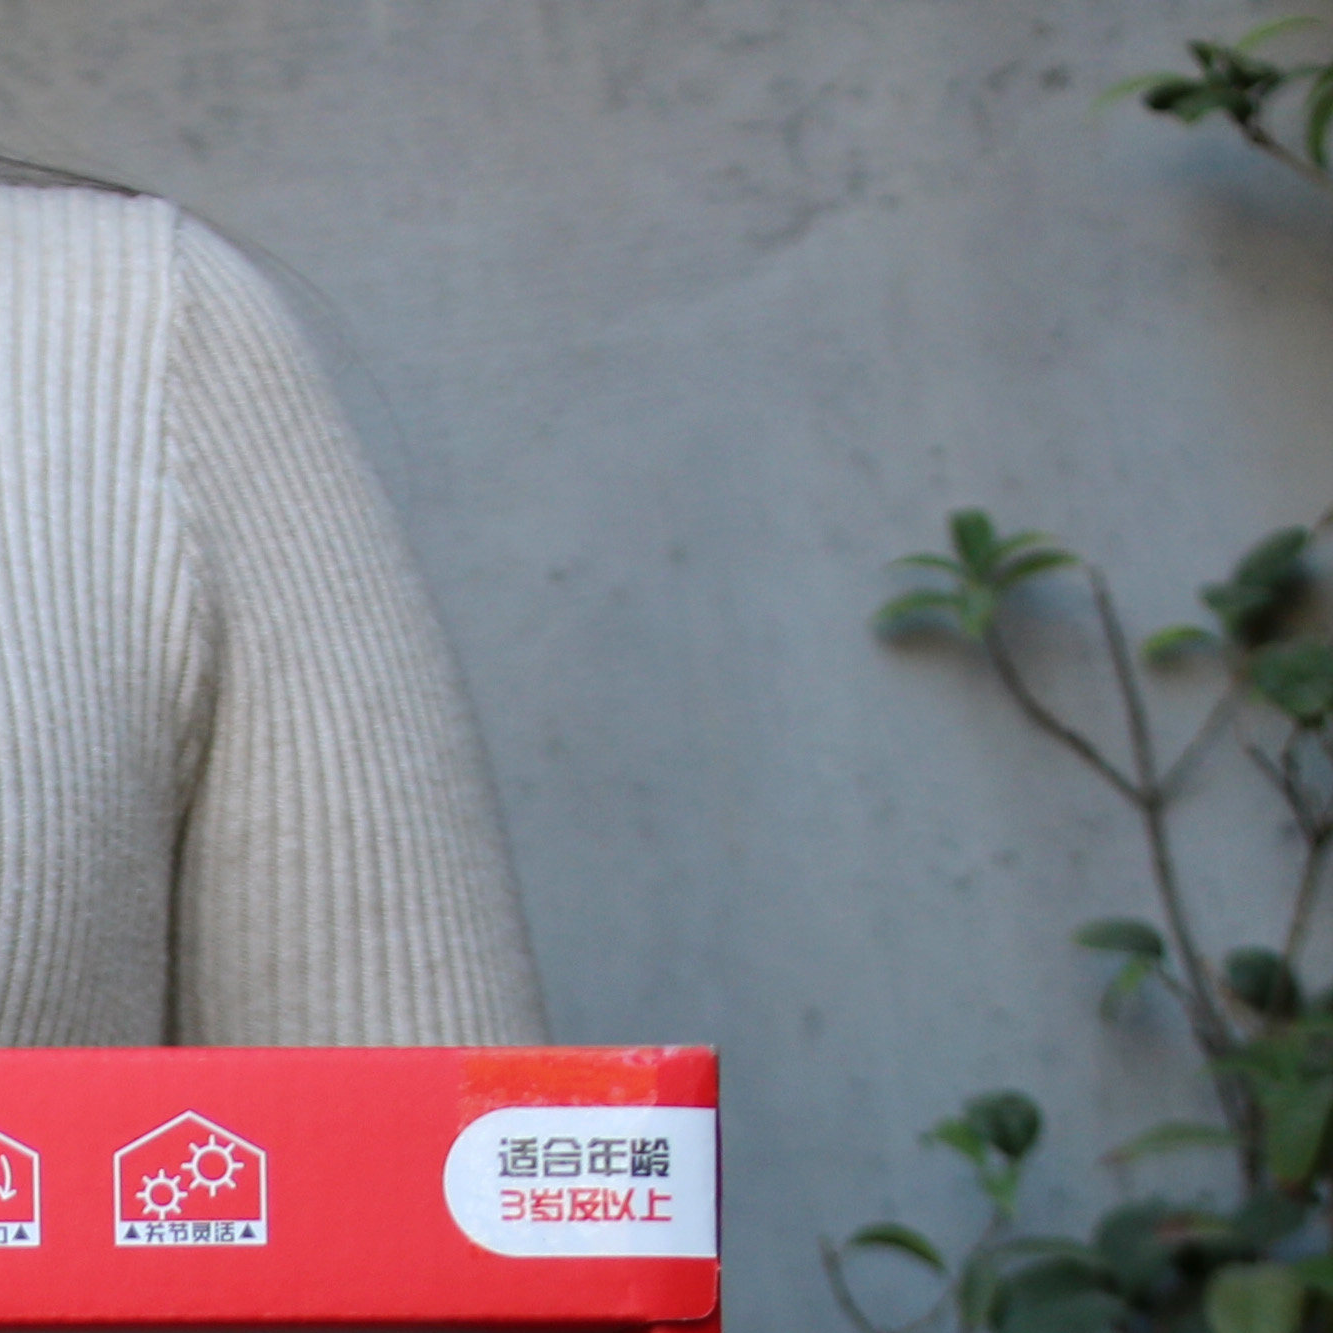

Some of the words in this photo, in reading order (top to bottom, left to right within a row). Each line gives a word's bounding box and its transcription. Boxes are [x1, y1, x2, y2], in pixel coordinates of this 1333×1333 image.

[498, 1138, 669, 1177] 适合年龄
[501, 1187, 672, 1221] 3岁及以上
[146, 1222, 235, 1242] 关节灵活
